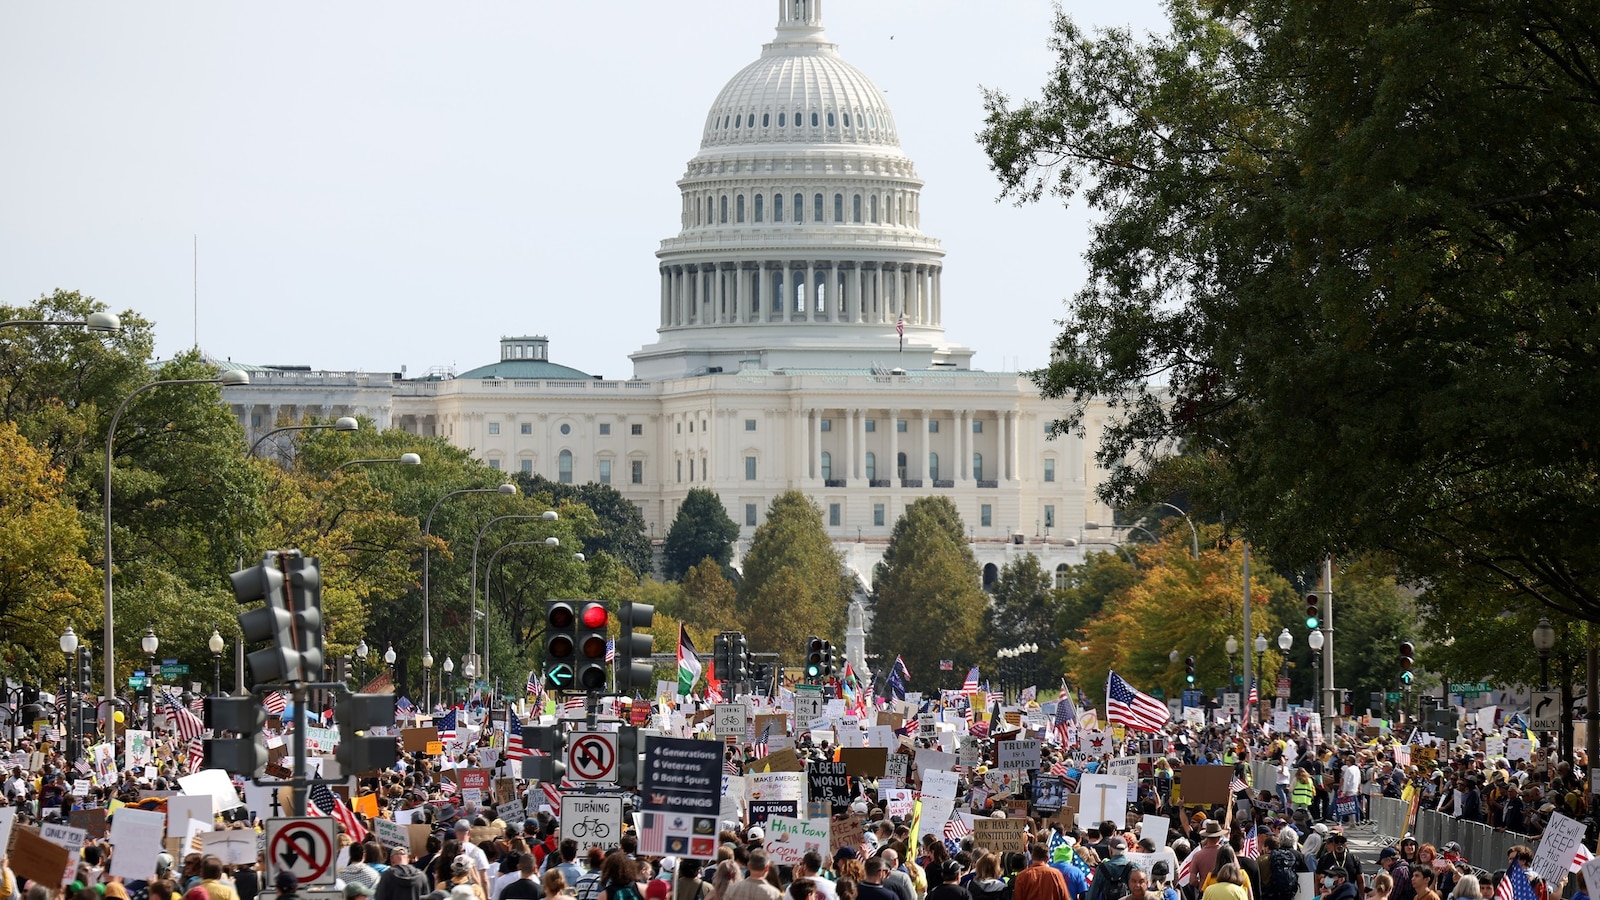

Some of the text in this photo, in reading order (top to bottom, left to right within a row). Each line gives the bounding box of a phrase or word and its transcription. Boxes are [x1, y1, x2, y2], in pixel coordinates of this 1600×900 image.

[306, 728, 339, 739] PSTEIN
[1003, 742, 1036, 750] TRUMP
[486, 750, 498, 761] NO
[662, 747, 716, 760] Generations
[887, 754, 908, 764] WHERE
[653, 760, 701, 772] 6 Veterans
[810, 764, 817, 774] A
[1004, 760, 1036, 768] RAPIST
[660, 774, 683, 783] Bone
[684, 775, 709, 786] Spurs
[812, 776, 846, 788] WORLD
[667, 796, 713, 807] NO KINGS
[574, 803, 610, 813] TURNING
[377, 820, 397, 832] HANDS
[832, 822, 849, 836] REE
[1551, 815, 1579, 837] WE will
[45, 827, 82, 842] ONLY YOU
[975, 832, 1021, 840] CONSTITUTION
[582, 842, 618, 851] X-WALKS
[1002, 842, 1019, 850] KING
[1545, 832, 1574, 853] KEEP
[1547, 848, 1560, 862] this
